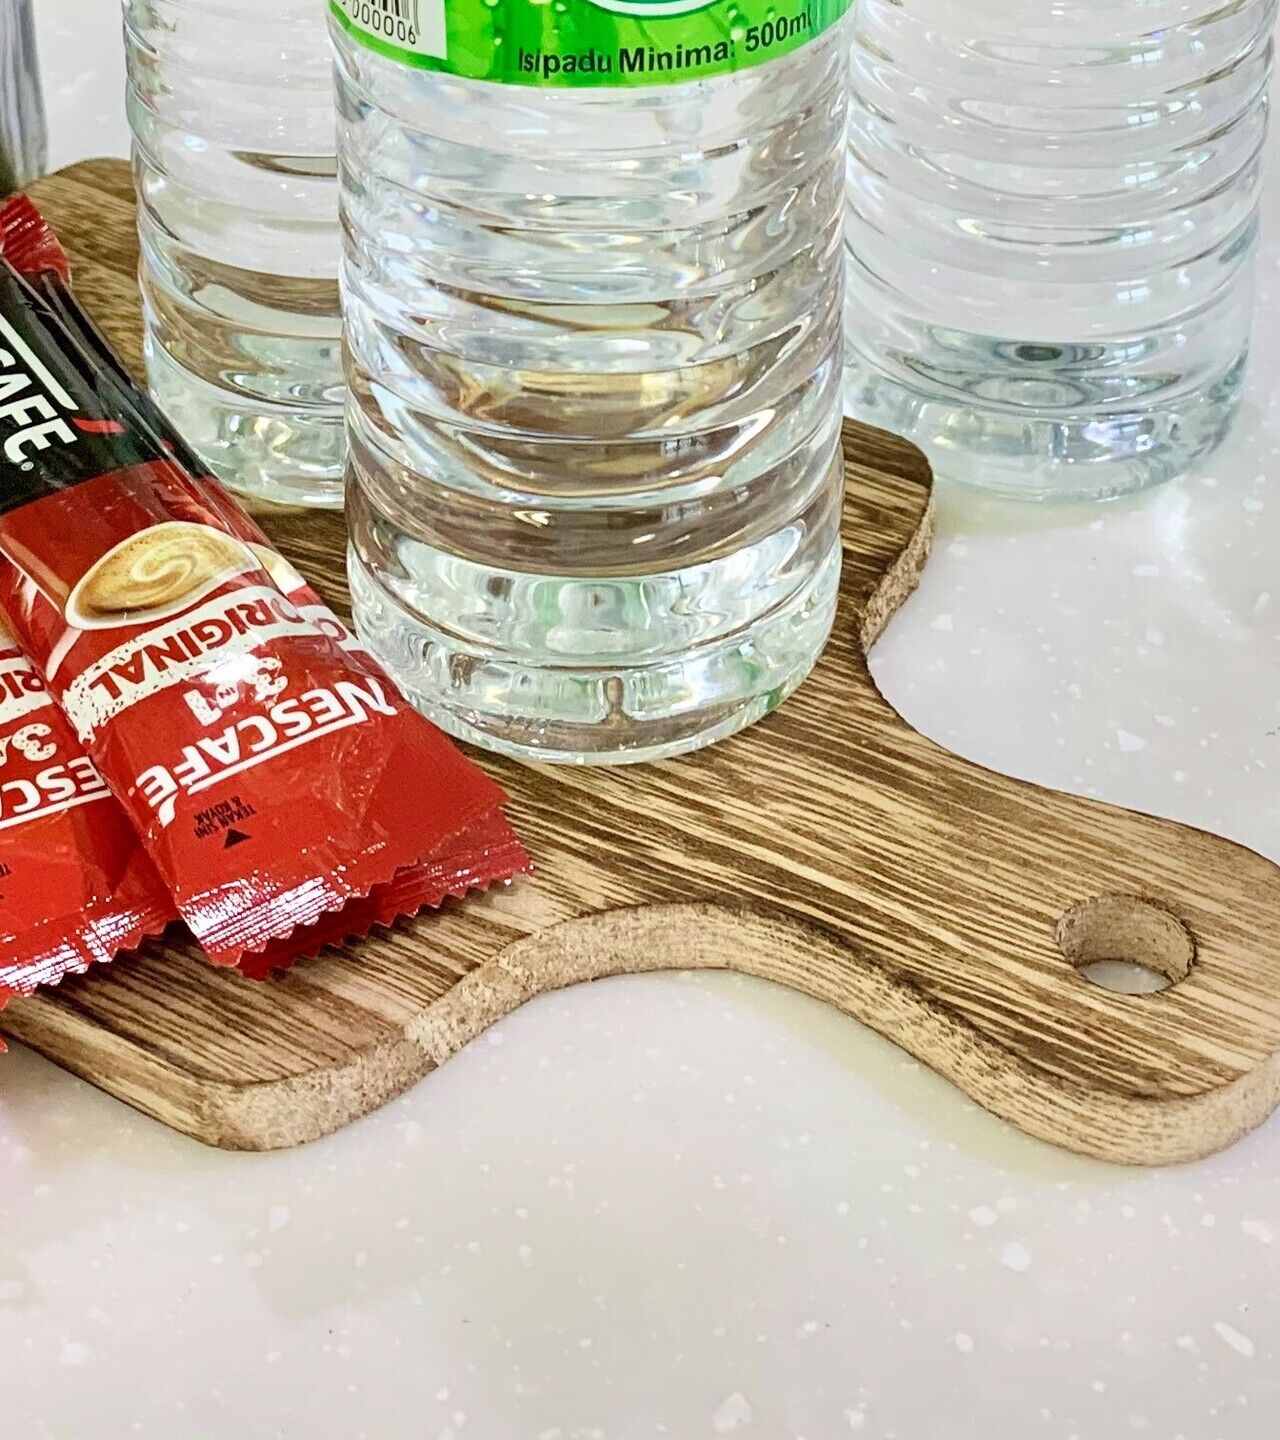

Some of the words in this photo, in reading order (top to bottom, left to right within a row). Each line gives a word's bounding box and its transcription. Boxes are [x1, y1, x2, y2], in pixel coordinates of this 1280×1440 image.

[518, 46, 613, 79] Isipadu
[618, 40, 735, 75] Minima:
[745, 2, 812, 53] 500ml
[11, 723, 57, 762] 3
